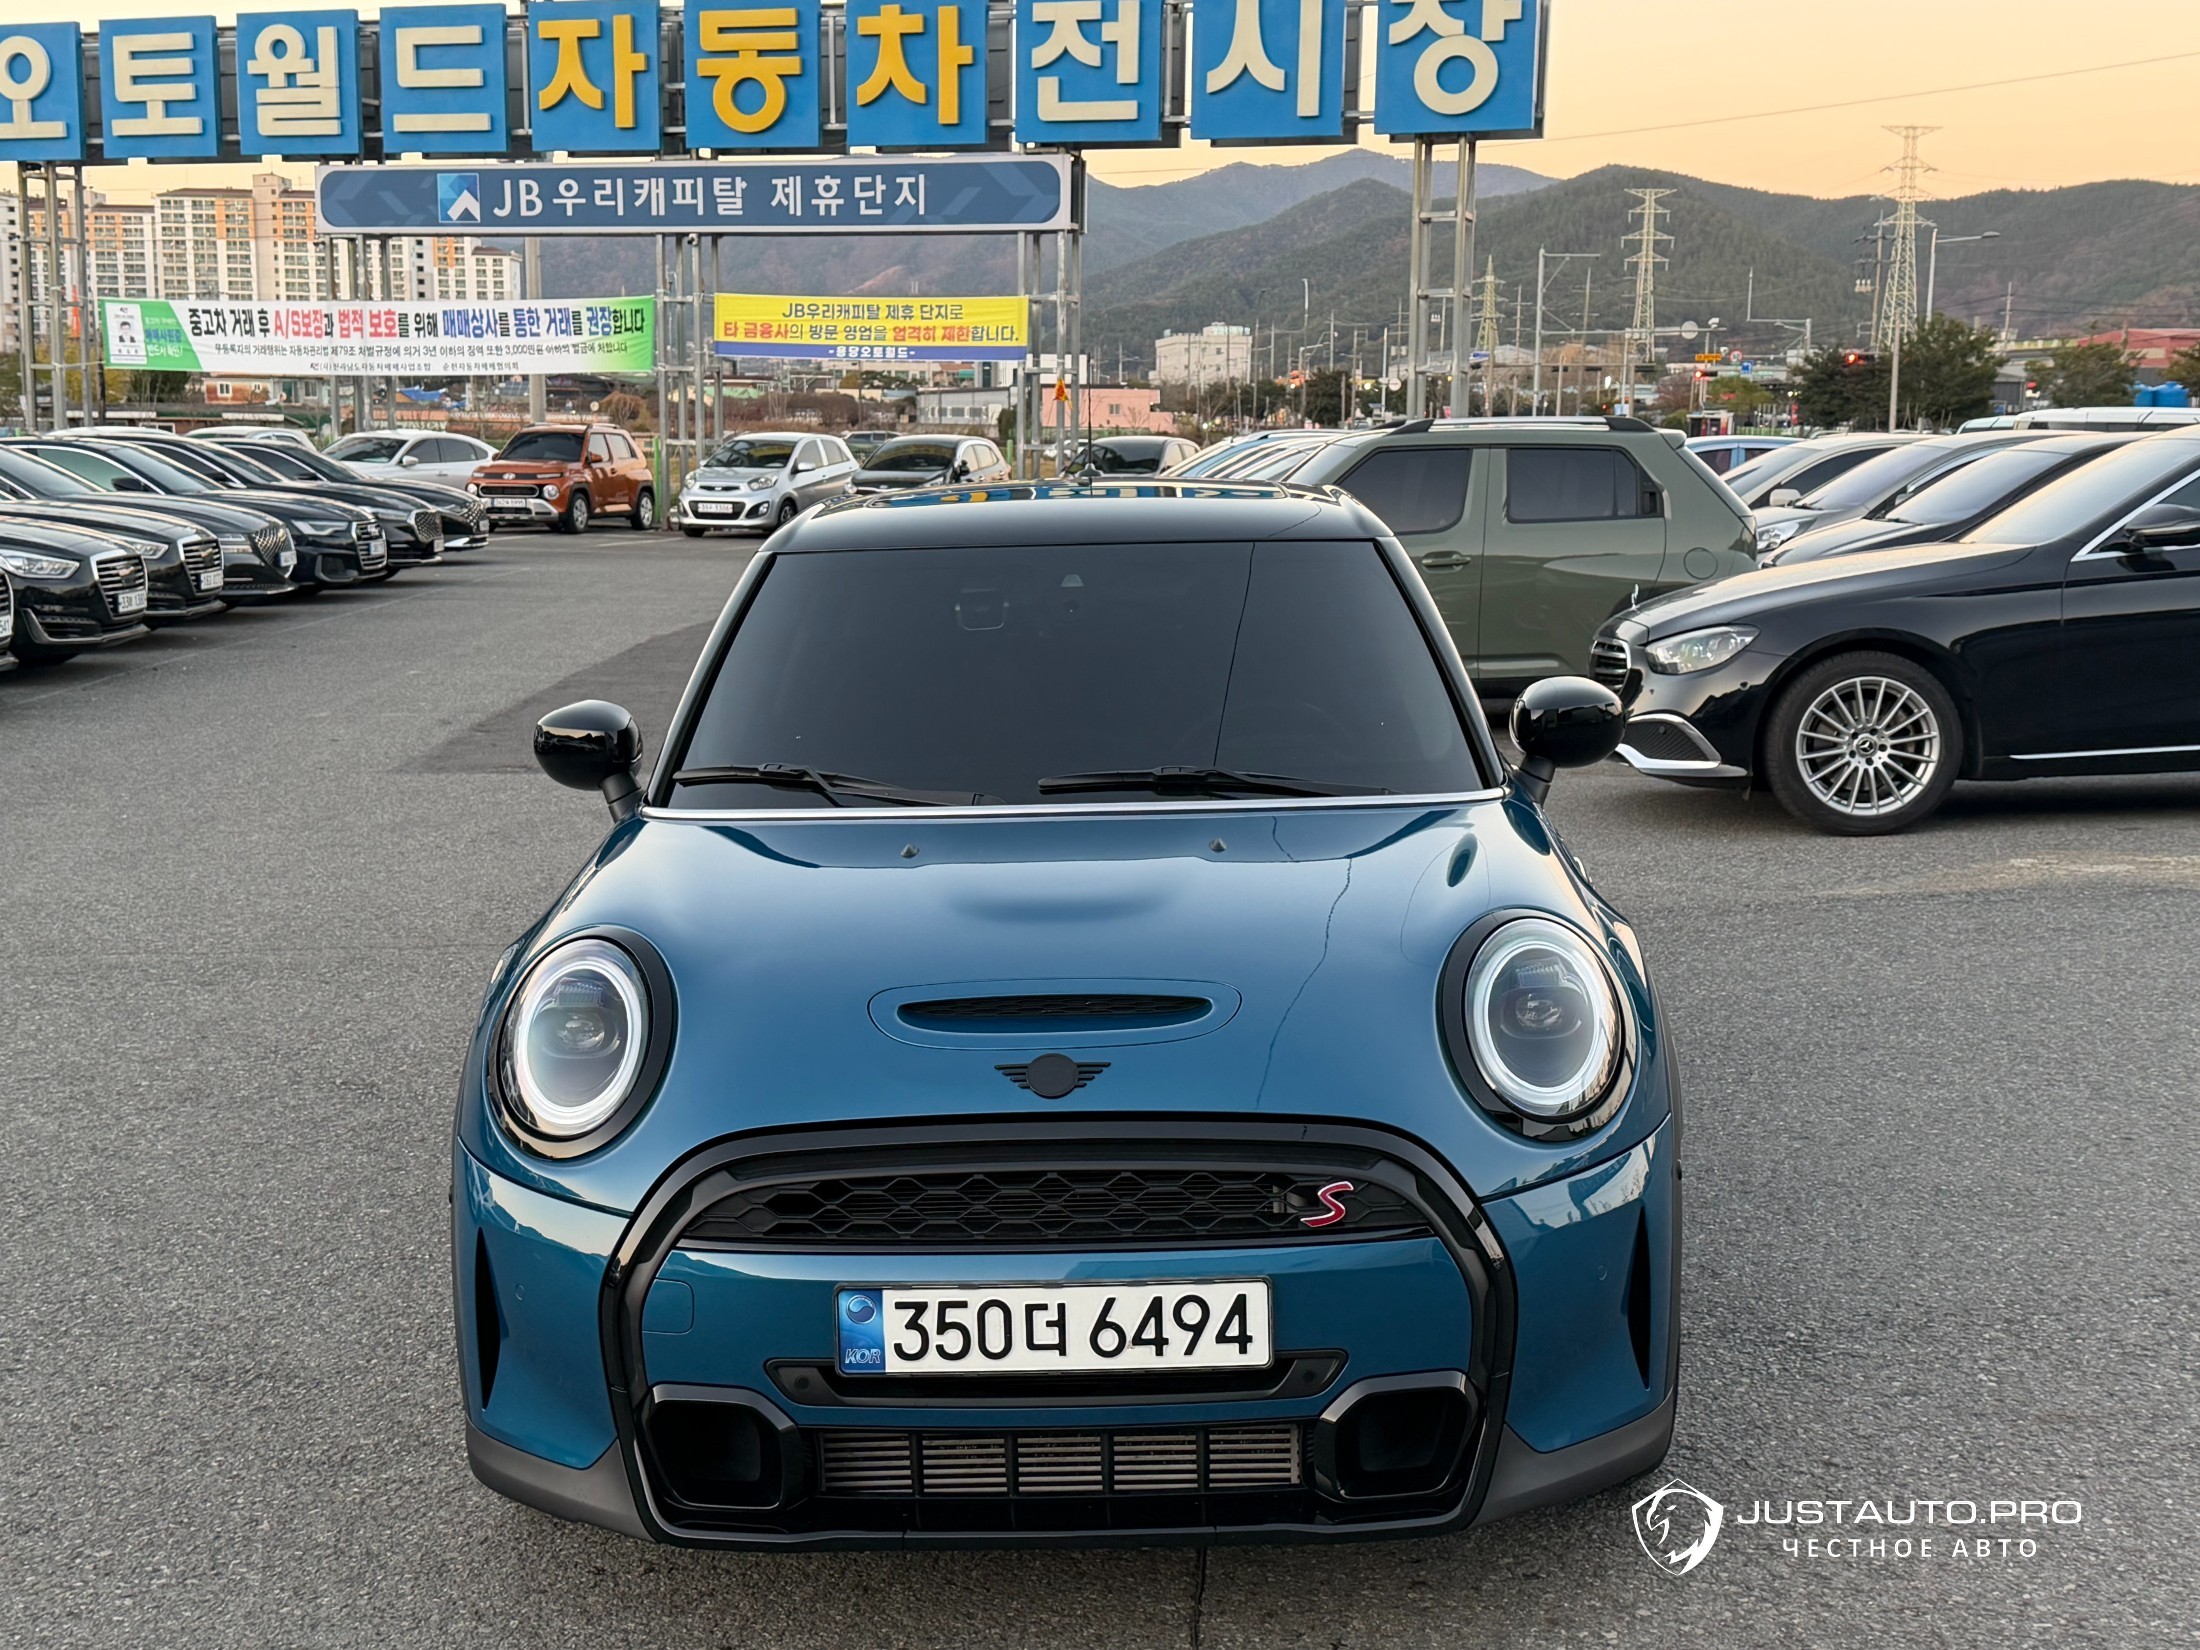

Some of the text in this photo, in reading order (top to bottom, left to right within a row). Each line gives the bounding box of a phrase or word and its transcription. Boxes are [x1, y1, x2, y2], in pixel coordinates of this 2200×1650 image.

[493, 174, 926, 217] JB우리캐피탈 제휴단지
[188, 305, 646, 340] 중고차 거래 후 A/S보장과 법적 보호를 위해 매매상사를 통한 거래를 권장합니다
[782, 303, 964, 321] JB우리캐피탈 제휴 단지로
[723, 321, 1020, 342] 타 금융사의 방문 영업을 엄격히 제한합니다.
[1301, 1180, 1354, 1228] S
[893, 1293, 1254, 1361] 350더 6494
[844, 1348, 882, 1364] KOR
